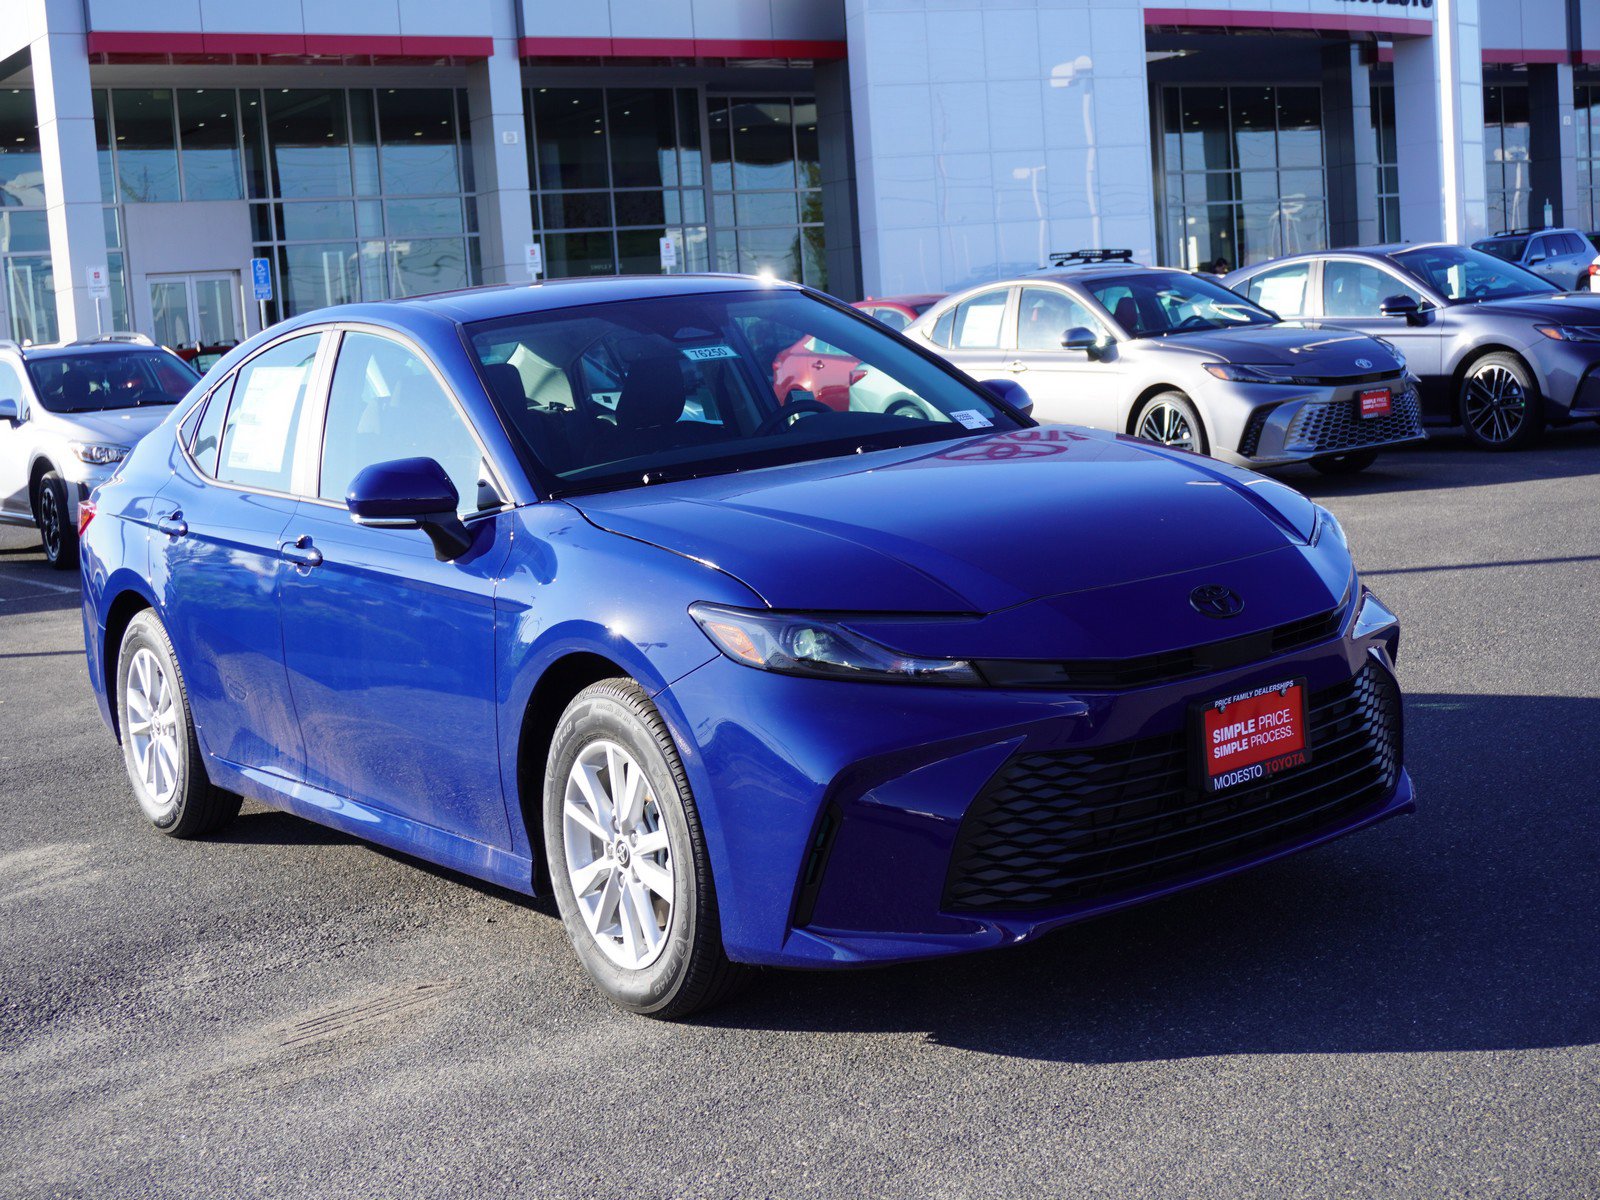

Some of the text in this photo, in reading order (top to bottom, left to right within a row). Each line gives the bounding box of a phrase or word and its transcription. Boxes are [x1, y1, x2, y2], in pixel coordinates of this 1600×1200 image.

[690, 347, 728, 359] 76250
[1214, 680, 1294, 708] PRICE FAMILY DEALERSHIPS
[1213, 708, 1293, 744] SIMPLE PRICE.
[1213, 725, 1294, 758] SIMPLE PROCESS.
[1214, 752, 1306, 790] MODESTO TOYOTA
